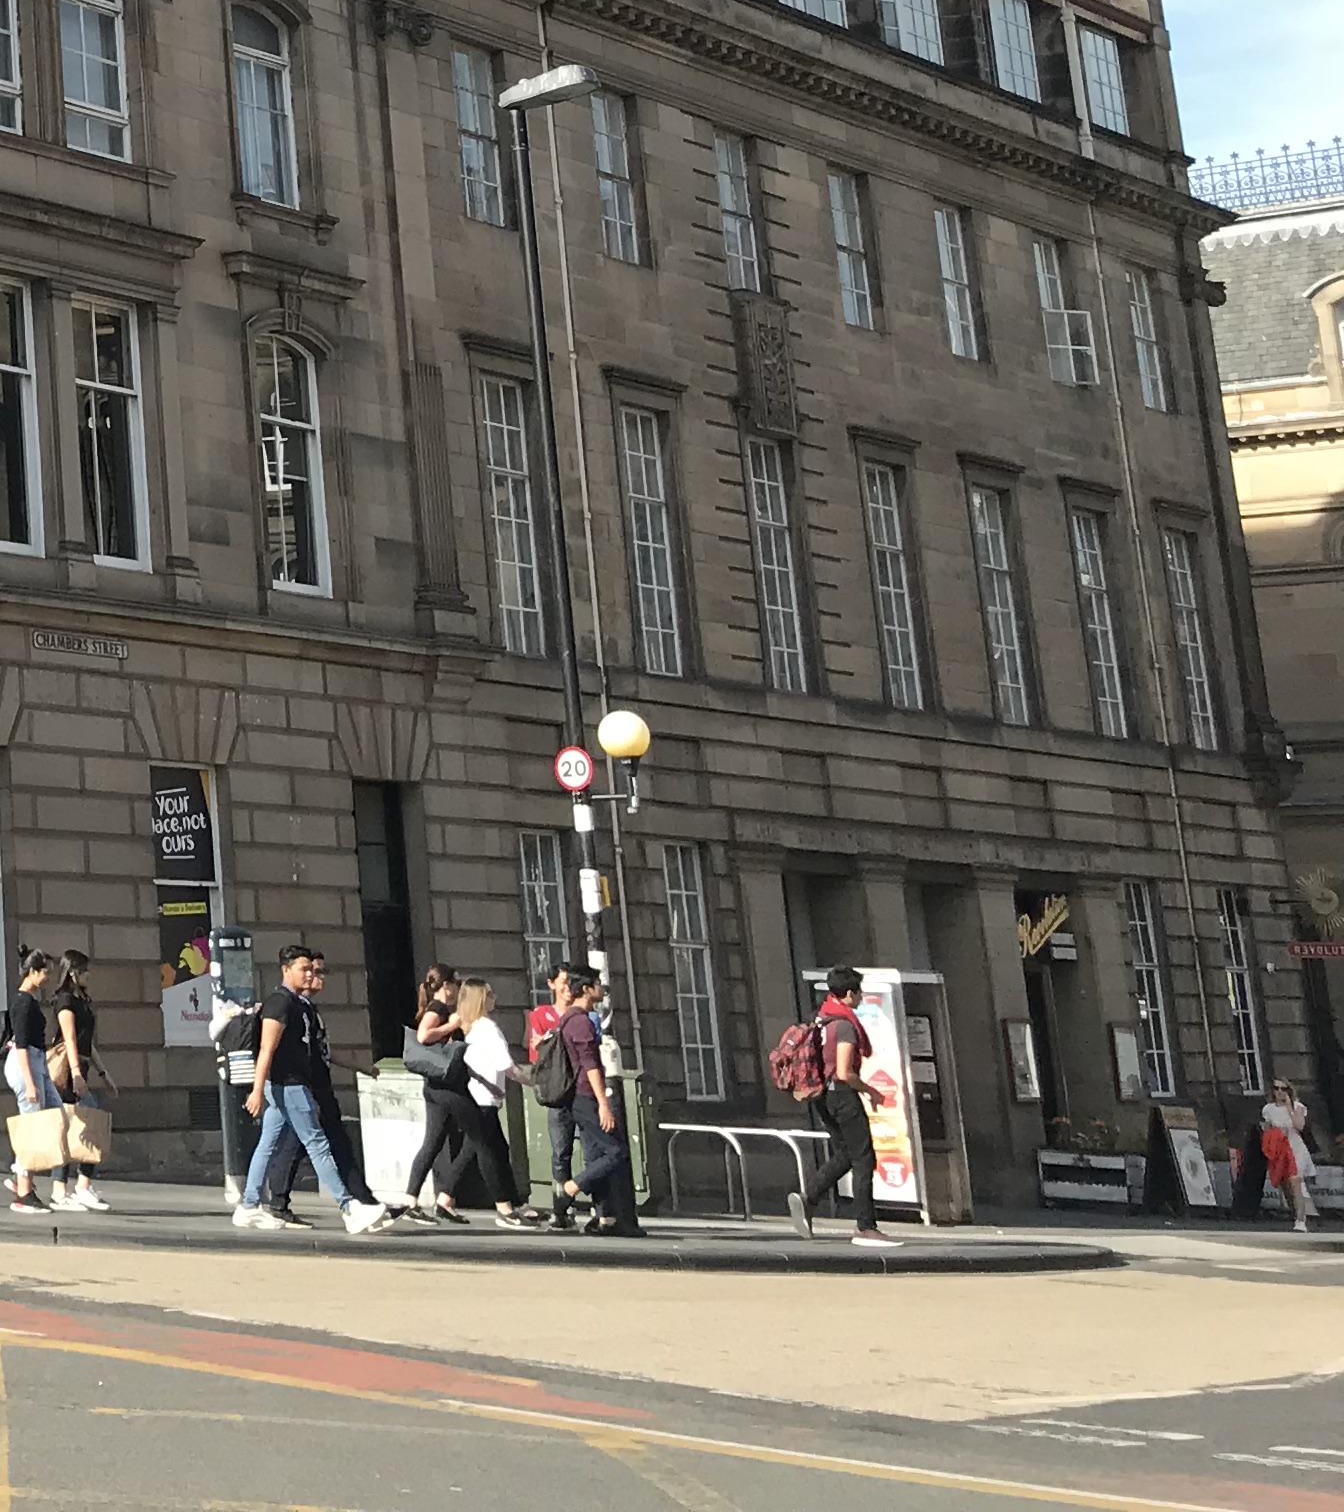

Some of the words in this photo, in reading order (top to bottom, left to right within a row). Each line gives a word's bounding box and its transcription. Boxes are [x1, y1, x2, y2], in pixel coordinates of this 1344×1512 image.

[35, 633, 89, 651] CHAMBERS
[92, 641, 126, 657] STREET
[561, 760, 587, 777] 20
[155, 795, 190, 816] Your
[162, 834, 195, 854] ours
